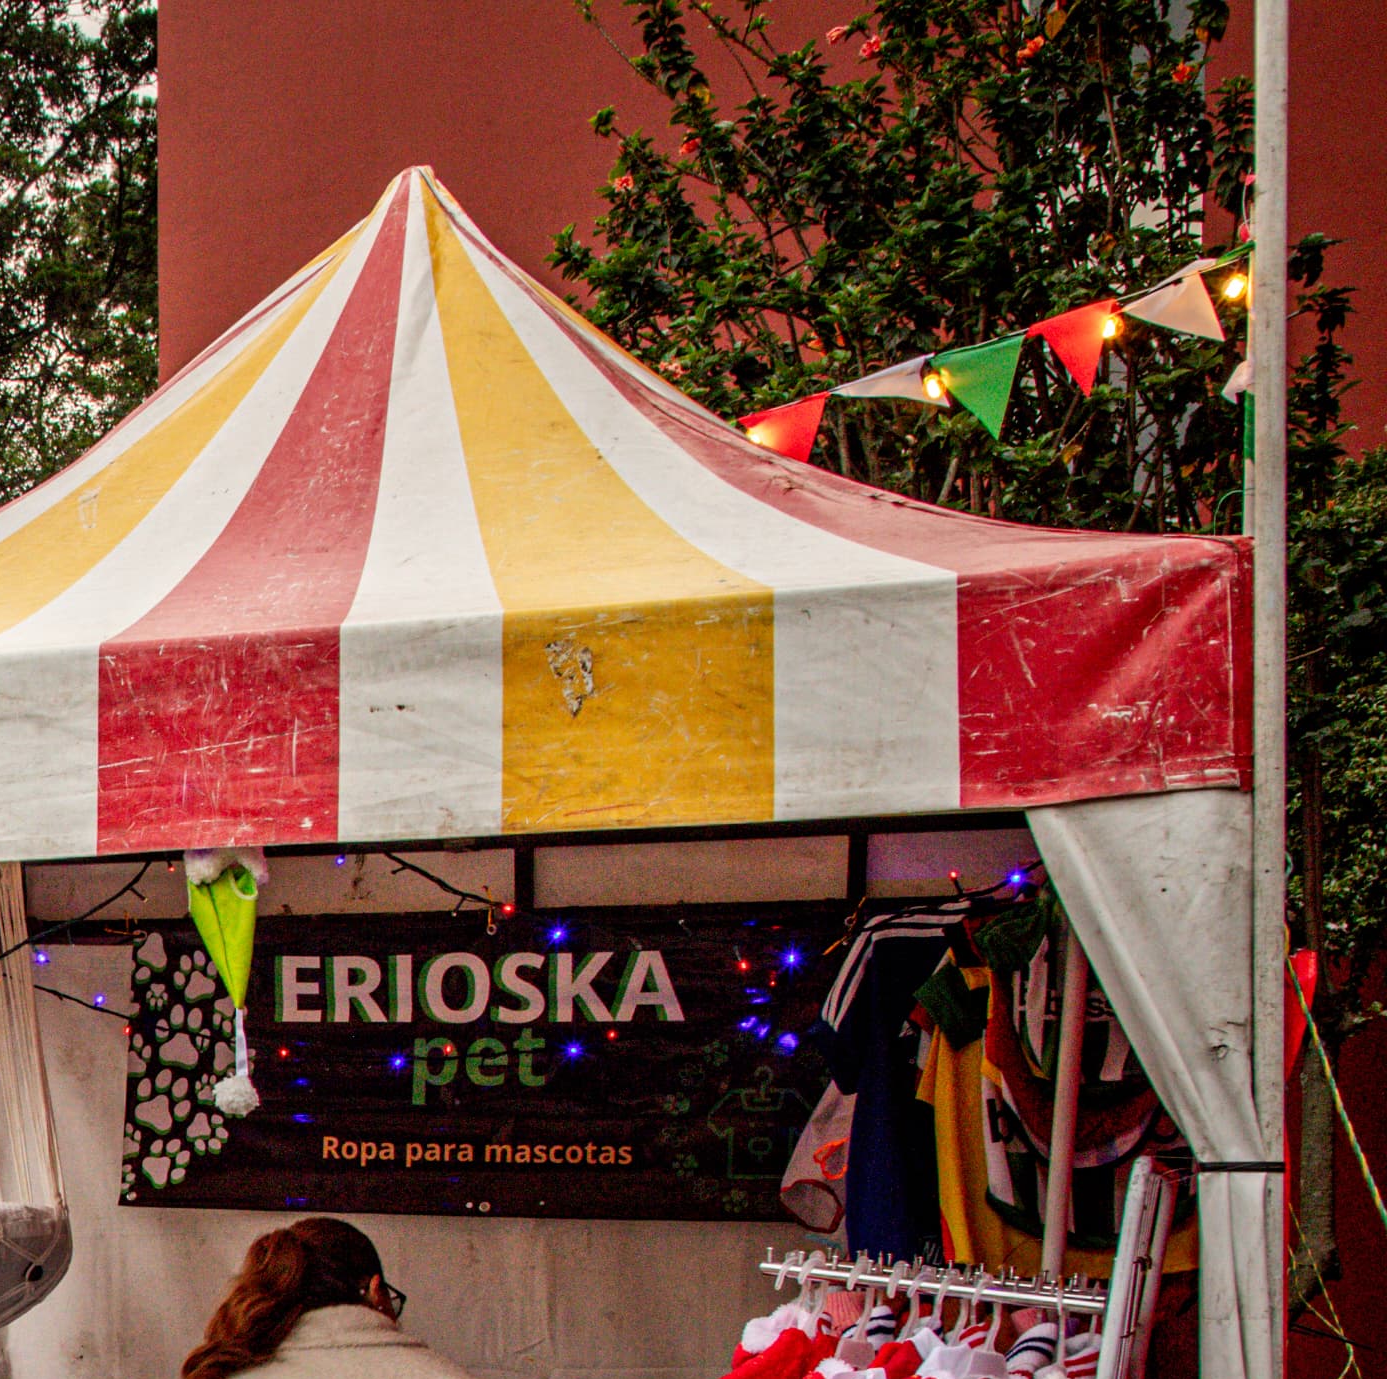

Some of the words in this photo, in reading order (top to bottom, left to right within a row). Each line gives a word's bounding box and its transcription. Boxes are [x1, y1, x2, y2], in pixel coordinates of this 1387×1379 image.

[274, 950, 686, 1024] ERIOSKA
[412, 1027, 546, 1105] pet
[321, 1135, 395, 1166] Ropa
[405, 1142, 474, 1166] para
[484, 1141, 633, 1165] mascotas
